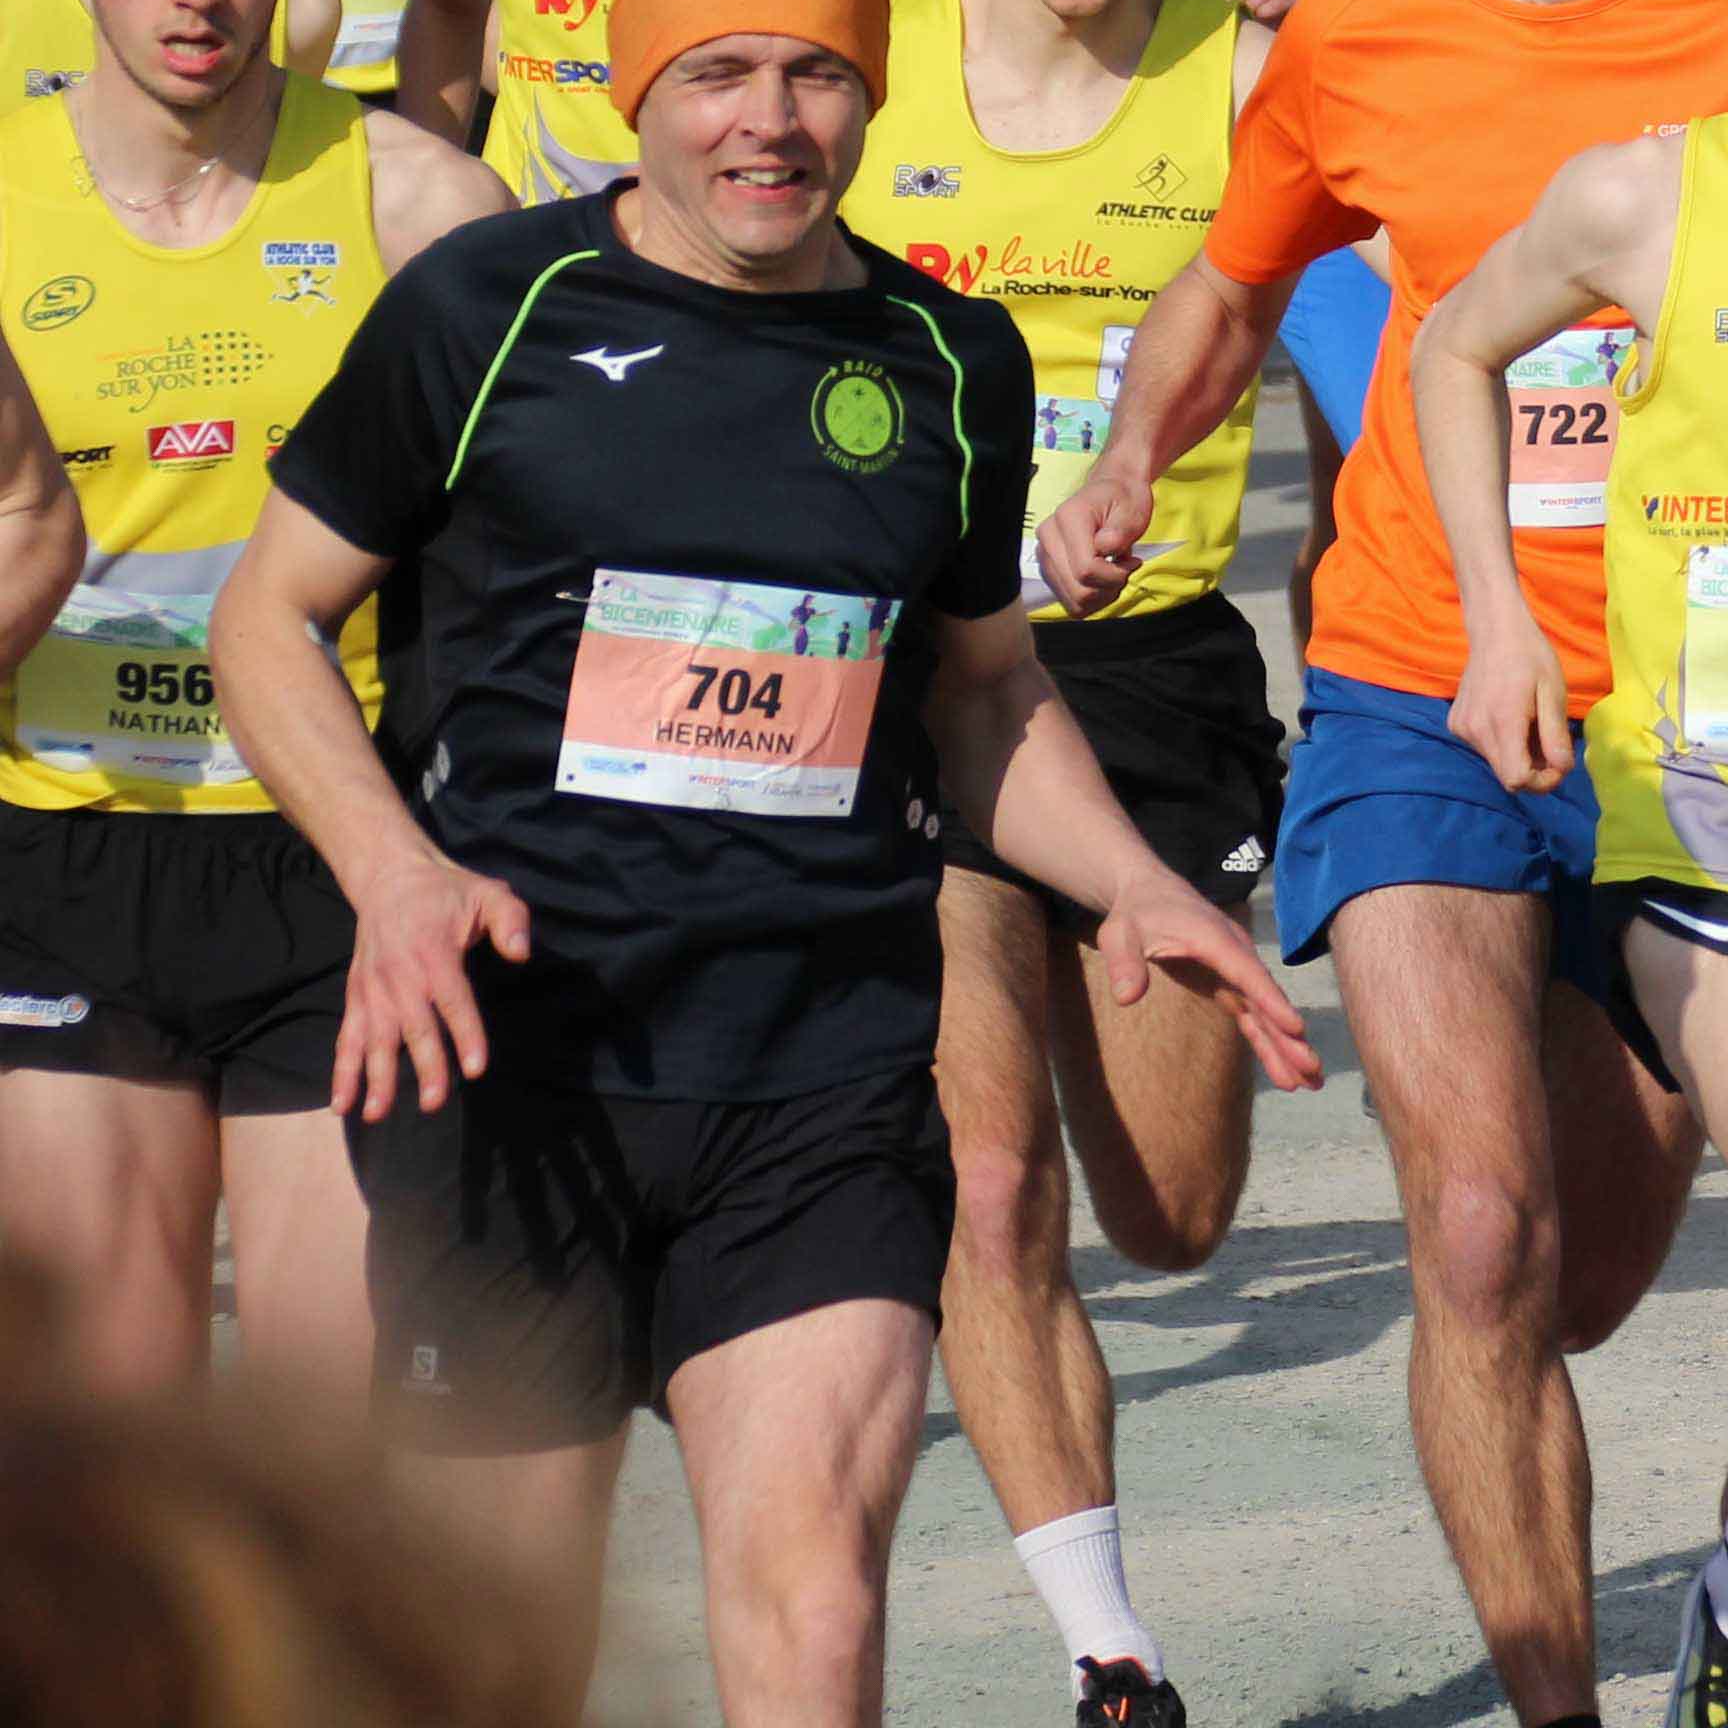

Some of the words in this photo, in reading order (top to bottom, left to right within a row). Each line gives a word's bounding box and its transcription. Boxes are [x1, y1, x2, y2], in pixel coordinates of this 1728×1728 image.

[895, 165, 963, 185] ROC
[1096, 202, 1175, 220] ATHLETIC
[990, 235, 1032, 277] la
[1043, 239, 1113, 279] ville
[981, 281, 1001, 296] La
[167, 335, 196, 352] LA
[116, 354, 197, 378] ROCHE
[96, 380, 142, 400] SUR
[1519, 402, 1609, 445] 722
[153, 421, 230, 457] AVA
[601, 604, 743, 635] BICENTENAIRE
[116, 662, 215, 707] 956
[684, 664, 784, 720] 704
[109, 709, 221, 735] NATHAN
[655, 719, 797, 755] HERMANN
